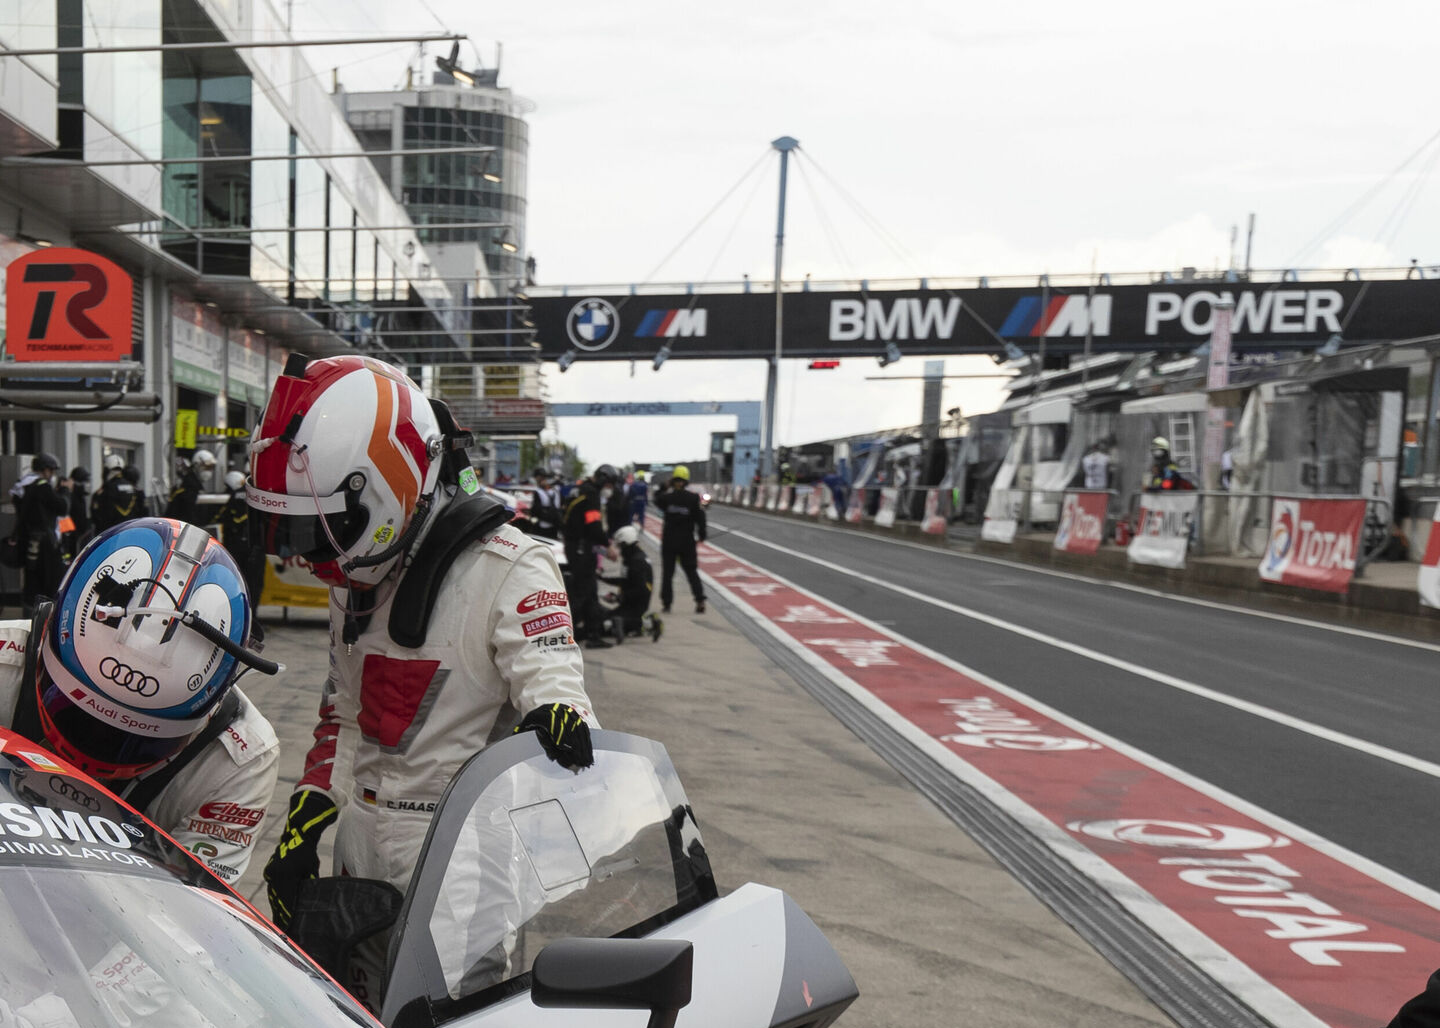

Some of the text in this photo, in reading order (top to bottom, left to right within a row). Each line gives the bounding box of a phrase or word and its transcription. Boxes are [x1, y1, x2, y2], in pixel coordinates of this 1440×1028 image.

[829, 296, 961, 342] BMW
[1144, 288, 1344, 336] POWER
[261, 495, 288, 509] Sport
[491, 535, 519, 551] Sport
[1297, 519, 1357, 571] TOTAL
[6, 640, 25, 653] Au
[86, 698, 161, 732] Audi Sport
[225, 725, 249, 752] port
[198, 801, 266, 827] Eibach
[386, 800, 439, 813] C.HAAS
[186, 819, 253, 847] FIRENZINI
[1159, 853, 1407, 968] TOTAL
[102, 950, 137, 979] Spor
